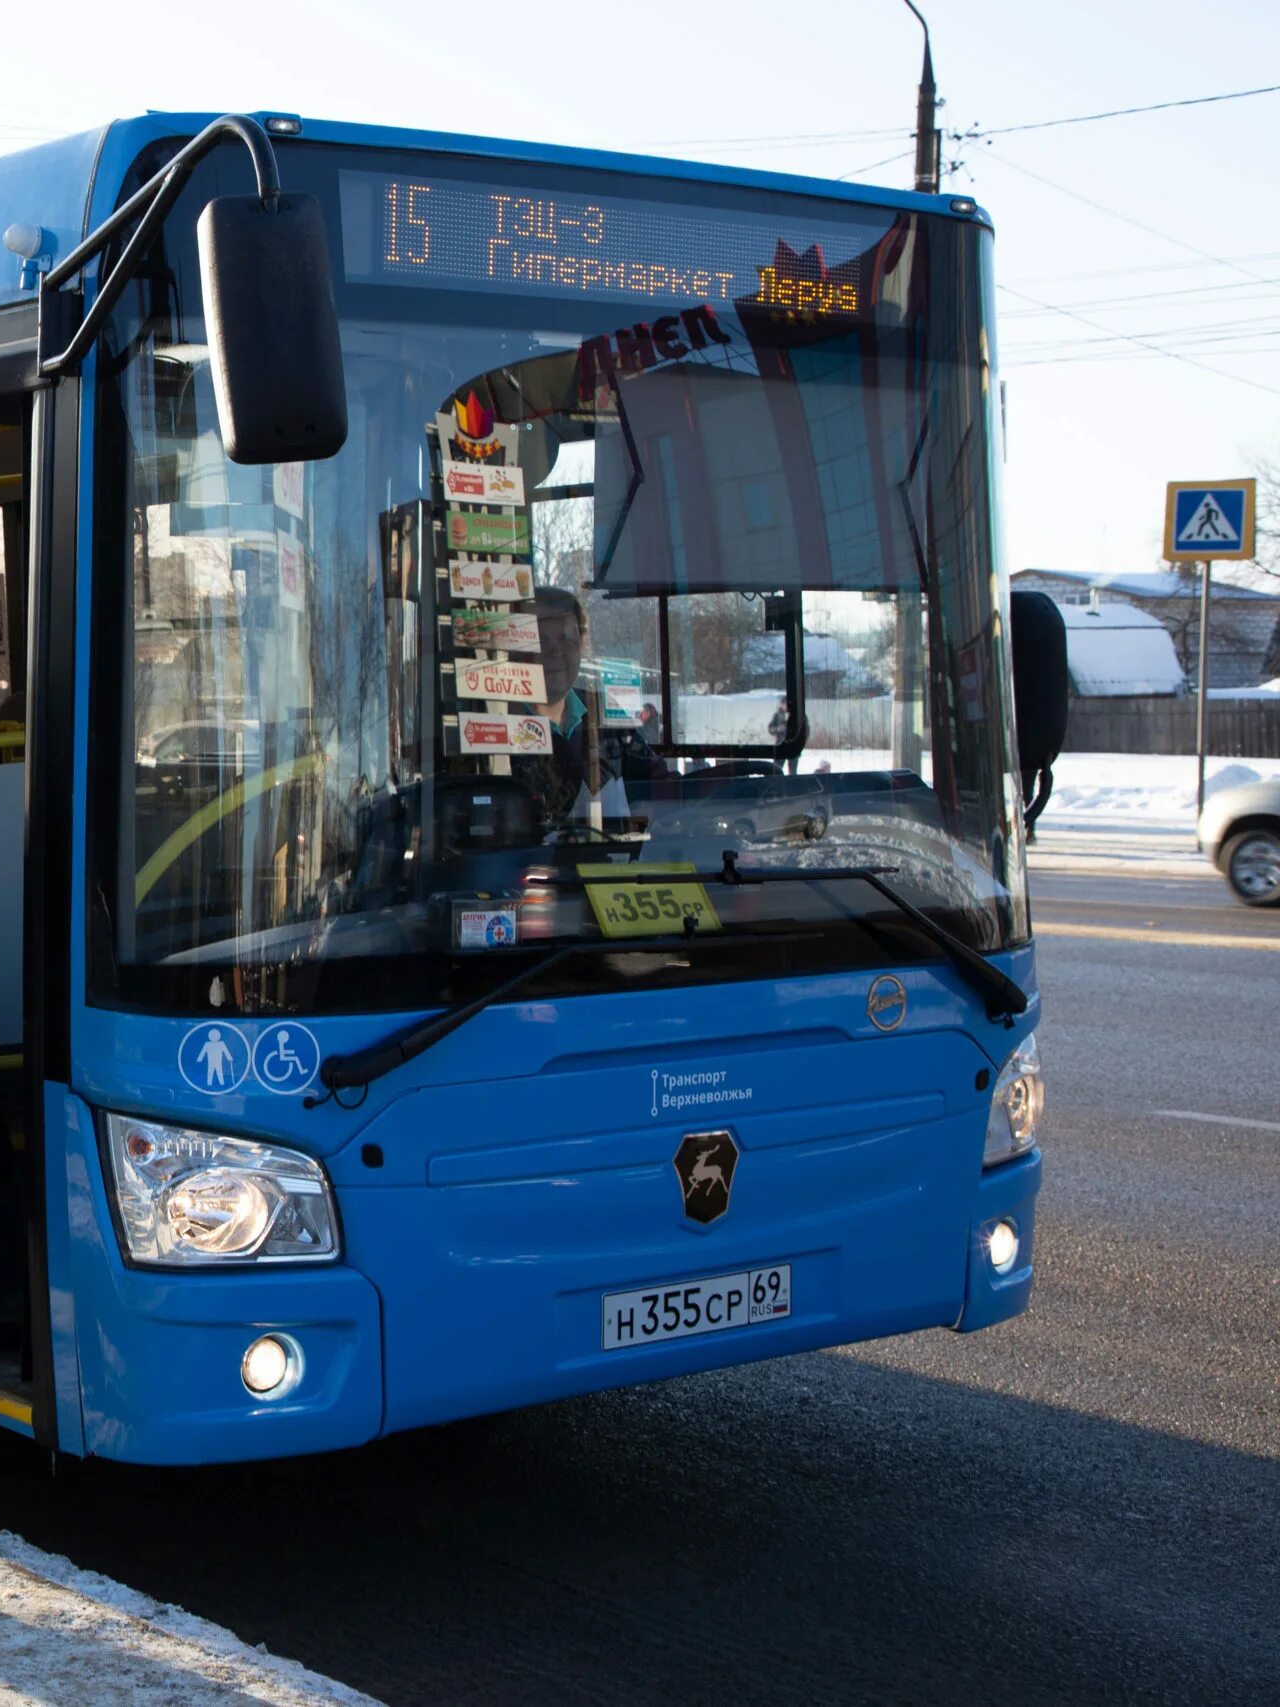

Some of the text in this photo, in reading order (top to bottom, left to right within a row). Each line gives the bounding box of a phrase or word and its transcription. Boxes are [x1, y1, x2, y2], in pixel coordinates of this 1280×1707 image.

[386, 182, 431, 265] 15
[491, 194, 605, 244] ТЭЦ-3
[488, 238, 858, 313] Гипермаркет Леруа
[607, 889, 704, 923] Н355СР
[662, 1070, 727, 1091] Транспорт
[662, 1087, 753, 1110] Верхневолжья
[617, 1271, 781, 1341] Н355СР 69
[751, 1303, 772, 1317] RUS
